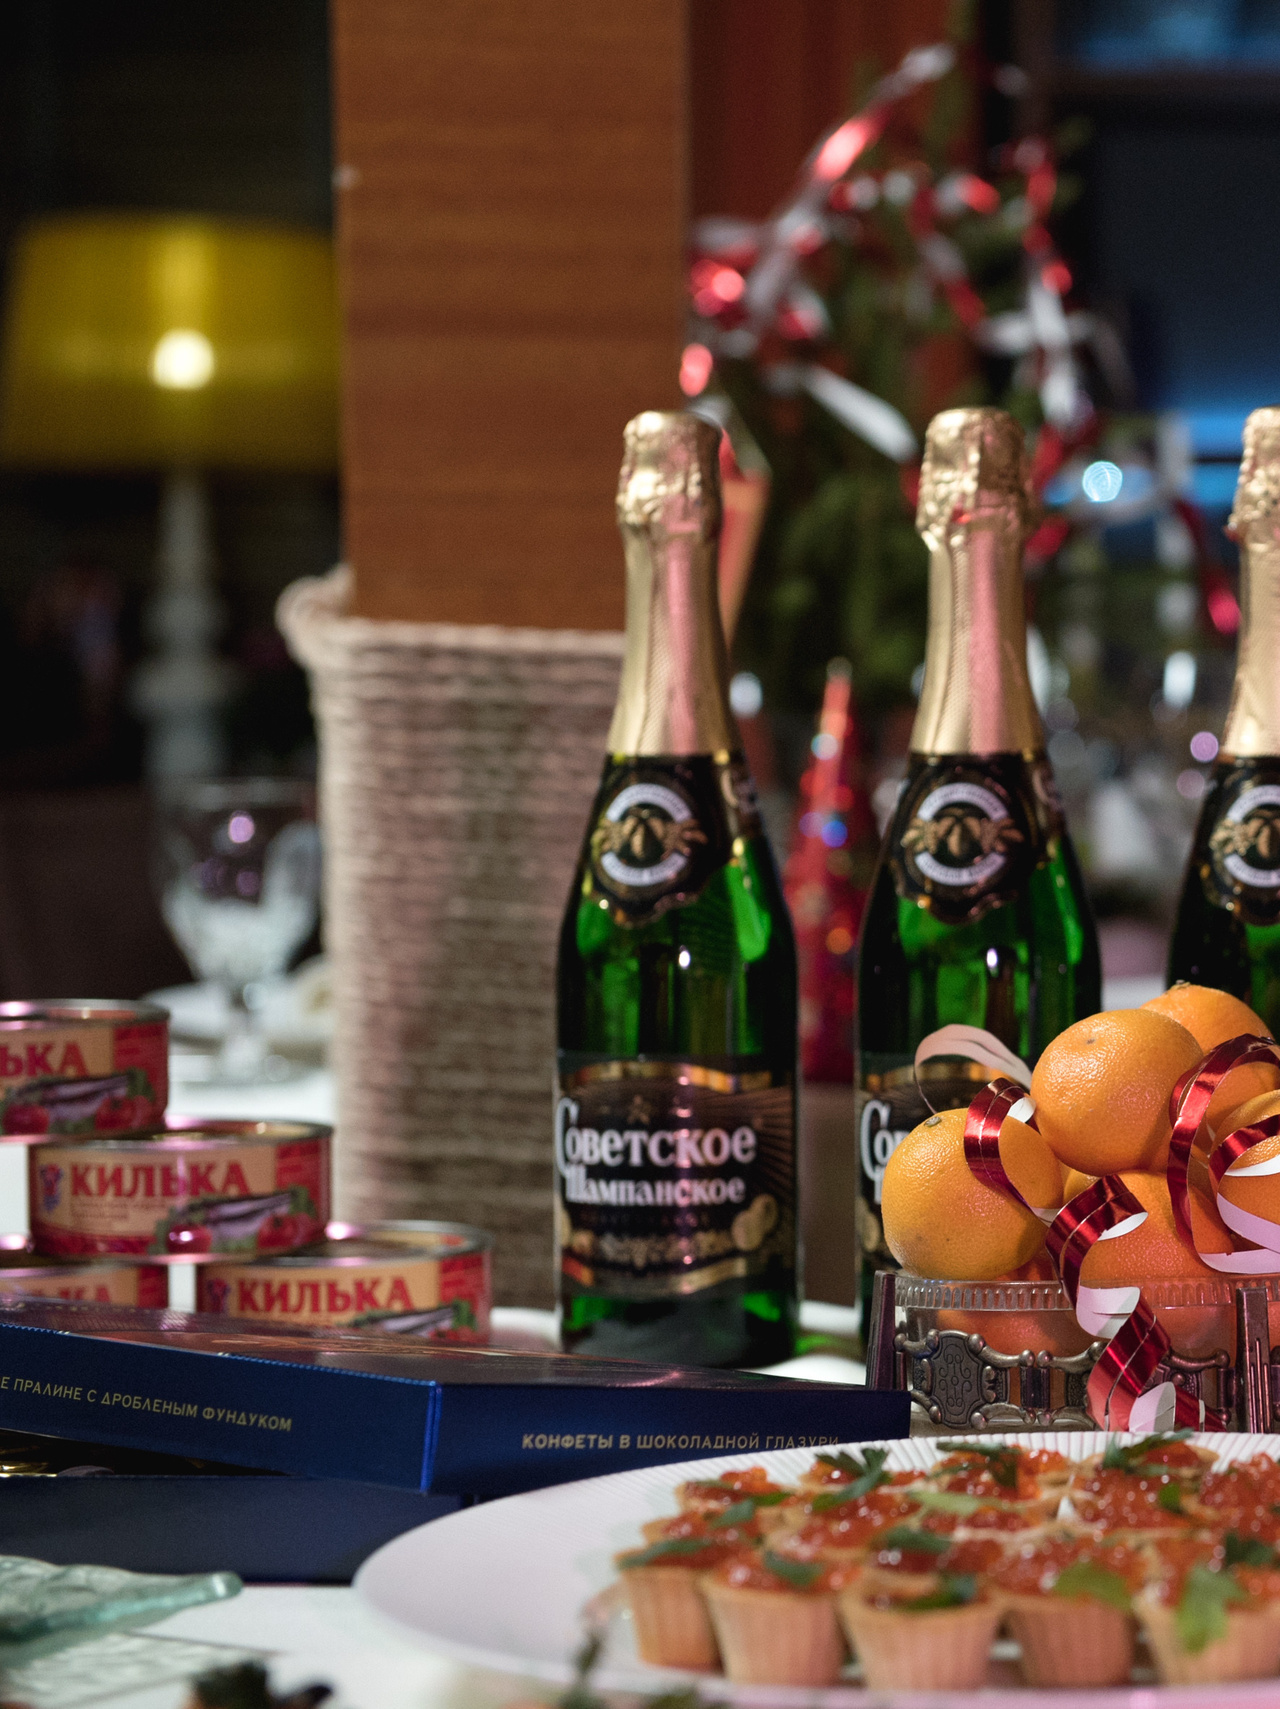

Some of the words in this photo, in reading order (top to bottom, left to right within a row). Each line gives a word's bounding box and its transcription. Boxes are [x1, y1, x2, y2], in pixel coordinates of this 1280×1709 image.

[556, 1097, 757, 1178] Советское
[69, 1161, 252, 1198] КИЛЬКА
[565, 1164, 746, 1207] Шампанское
[237, 1277, 415, 1314] КИЛЬКА
[14, 1378, 83, 1400] ПРАЛИНЕ
[87, 1389, 97, 1402] С
[101, 1392, 198, 1418] ДРОБЛЕНЫМ
[202, 1407, 292, 1432] ФУНДУКОМ
[522, 1434, 613, 1449] КОНФЕТЫ
[619, 1434, 631, 1449] В
[636, 1432, 759, 1449] ШОКОЛАДНОЙ
[765, 1435, 839, 1449] ГЛАЗУРИ
